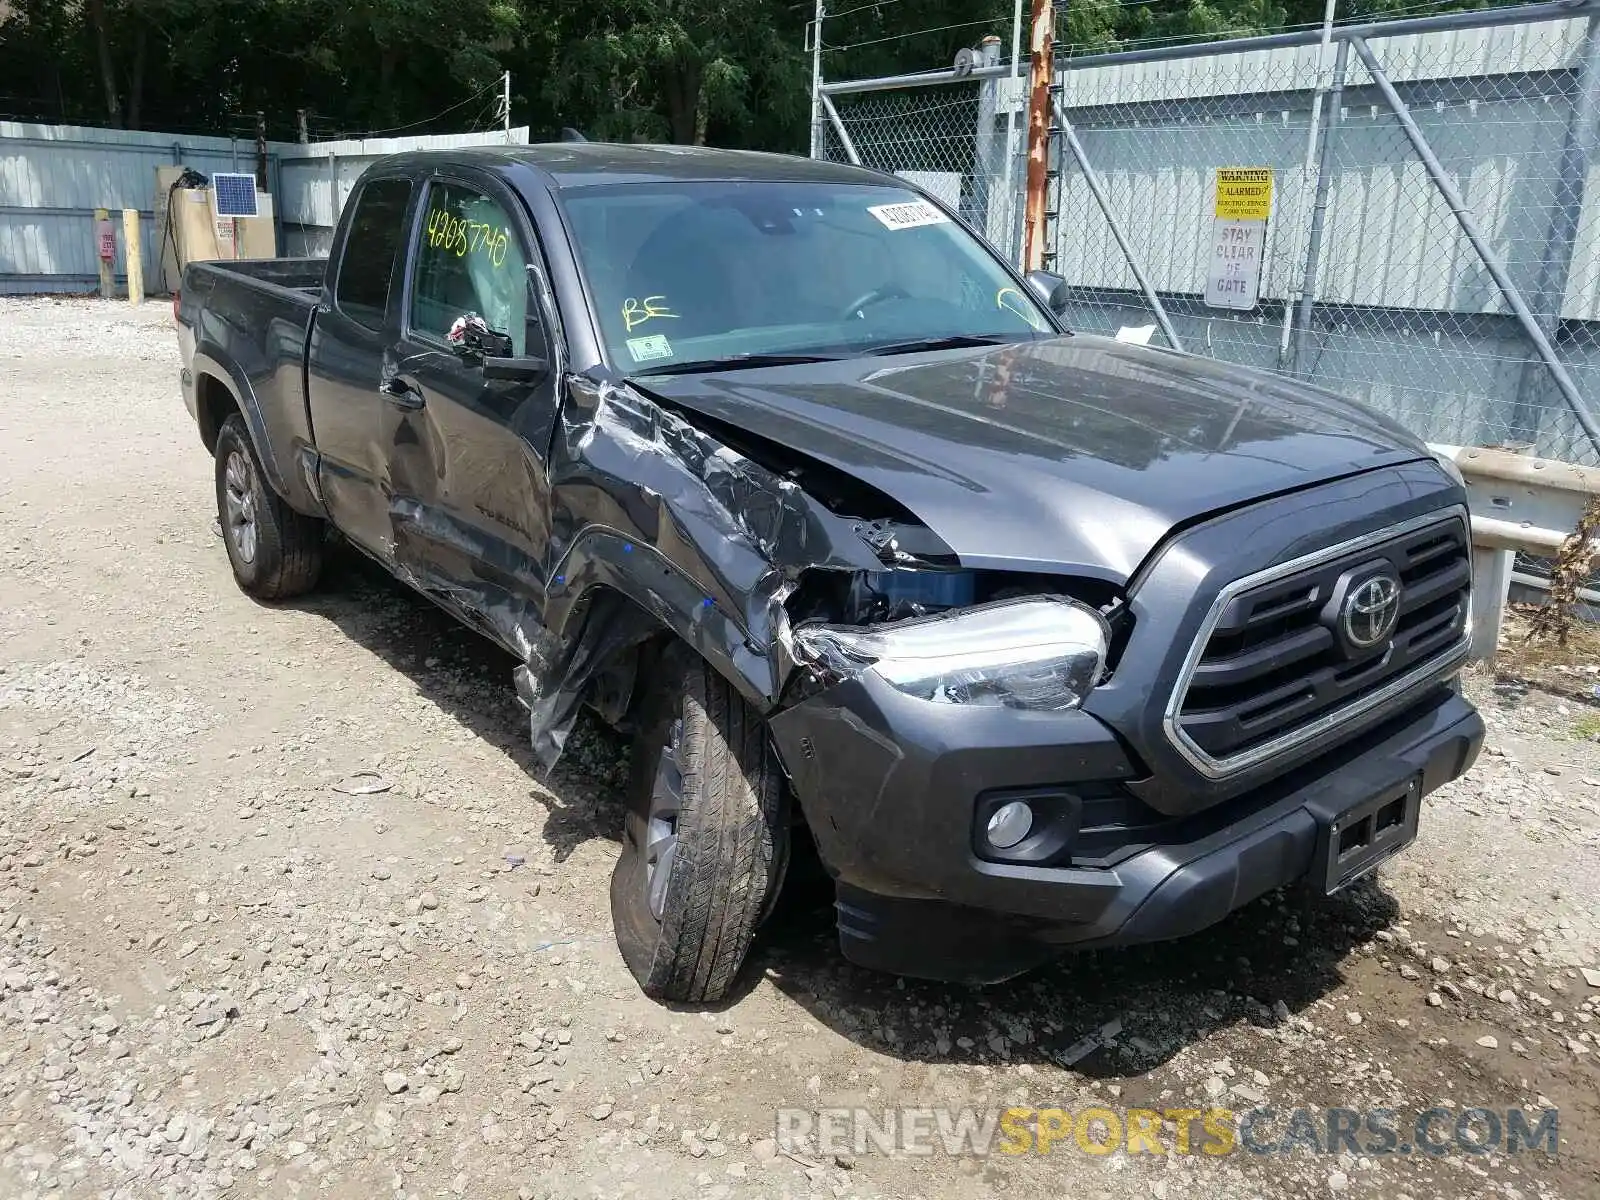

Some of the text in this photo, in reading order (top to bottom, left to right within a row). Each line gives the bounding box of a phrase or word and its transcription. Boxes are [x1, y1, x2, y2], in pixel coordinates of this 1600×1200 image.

[1220, 169, 1269, 182] WARNING
[1225, 187, 1263, 196] ALARMED
[428, 208, 508, 267] 42087740
[1222, 226, 1253, 242] STAY
[1216, 244, 1255, 260] CLEAR
[1216, 279, 1247, 294] GATE
